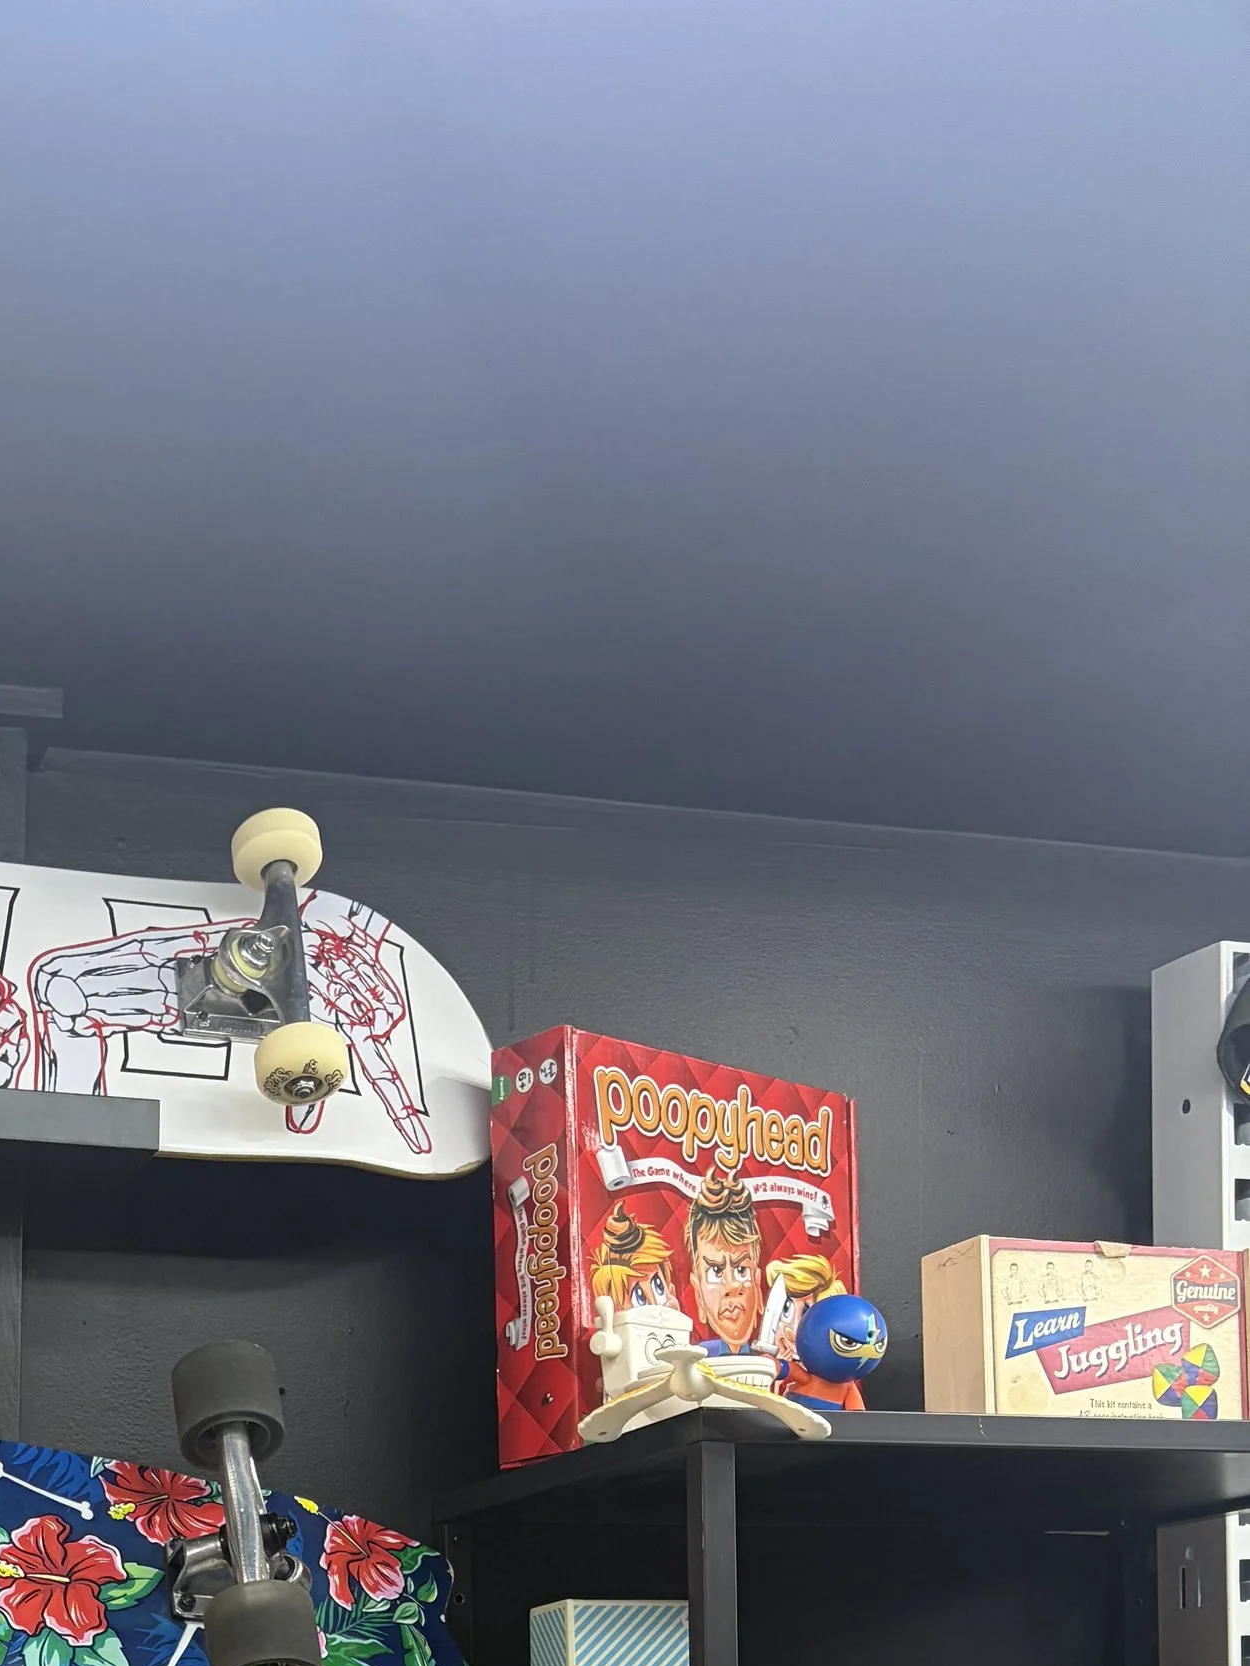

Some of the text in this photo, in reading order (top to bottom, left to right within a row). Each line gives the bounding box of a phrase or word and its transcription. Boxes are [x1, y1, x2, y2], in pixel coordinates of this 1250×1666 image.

[595, 1067, 832, 1176] poopyhead
[632, 1166, 697, 1193] The Game where
[769, 1182, 796, 1196] always
[796, 1185, 818, 1202] wins!
[524, 1143, 567, 1361] poopyhead
[1176, 1280, 1236, 1302] Genuine
[1193, 1304, 1219, 1315] quality
[1013, 1311, 1081, 1349] Learn
[1053, 1322, 1183, 1379] Juggling
[1090, 1398, 1106, 1408] This
[1106, 1400, 1116, 1408] kit
[1117, 1401, 1146, 1410] contains
